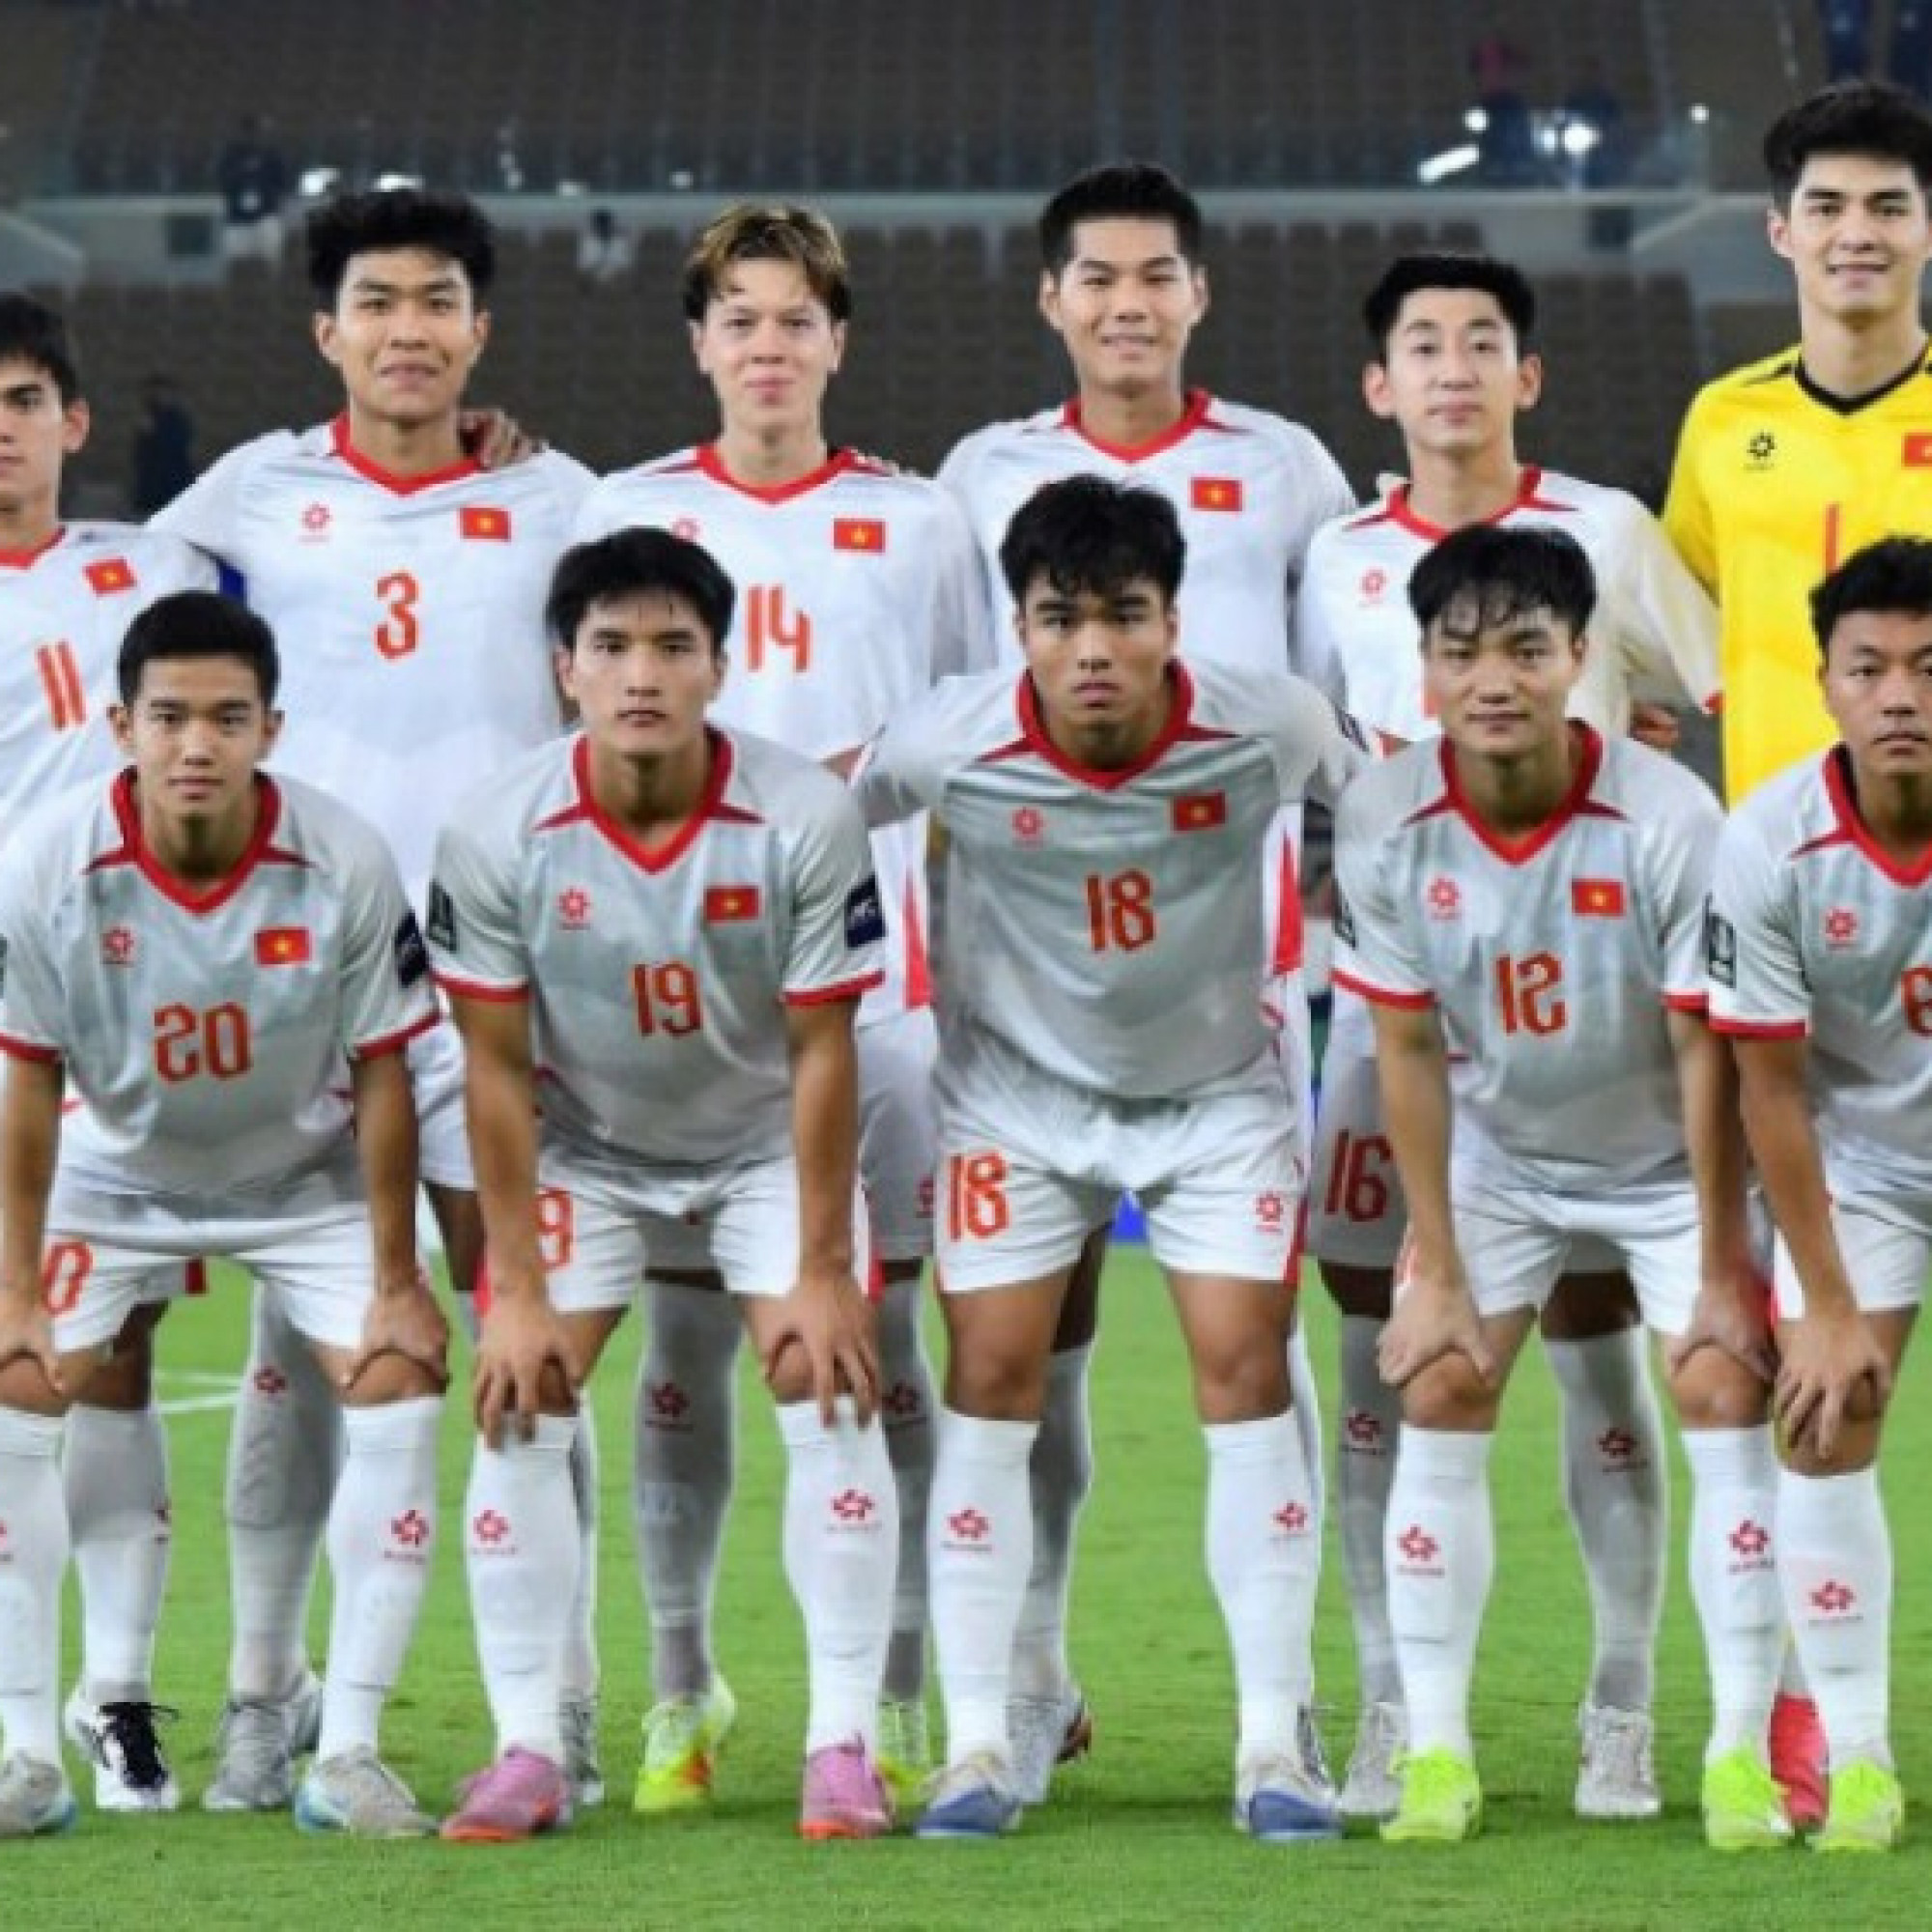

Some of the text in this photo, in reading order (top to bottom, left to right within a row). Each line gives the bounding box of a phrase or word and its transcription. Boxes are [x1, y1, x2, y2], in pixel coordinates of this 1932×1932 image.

[374, 572, 419, 660] 3
[746, 585, 811, 671] 14
[37, 641, 86, 730] 11
[1085, 869, 1155, 952] 18
[632, 962, 701, 1037] 19
[1492, 952, 1566, 1037] 12
[153, 1003, 250, 1083] 20
[948, 1151, 1009, 1242] 18
[1325, 1129, 1393, 1222] 16
[529, 1189, 574, 1271] 9
[41, 1241, 94, 1316] 0
